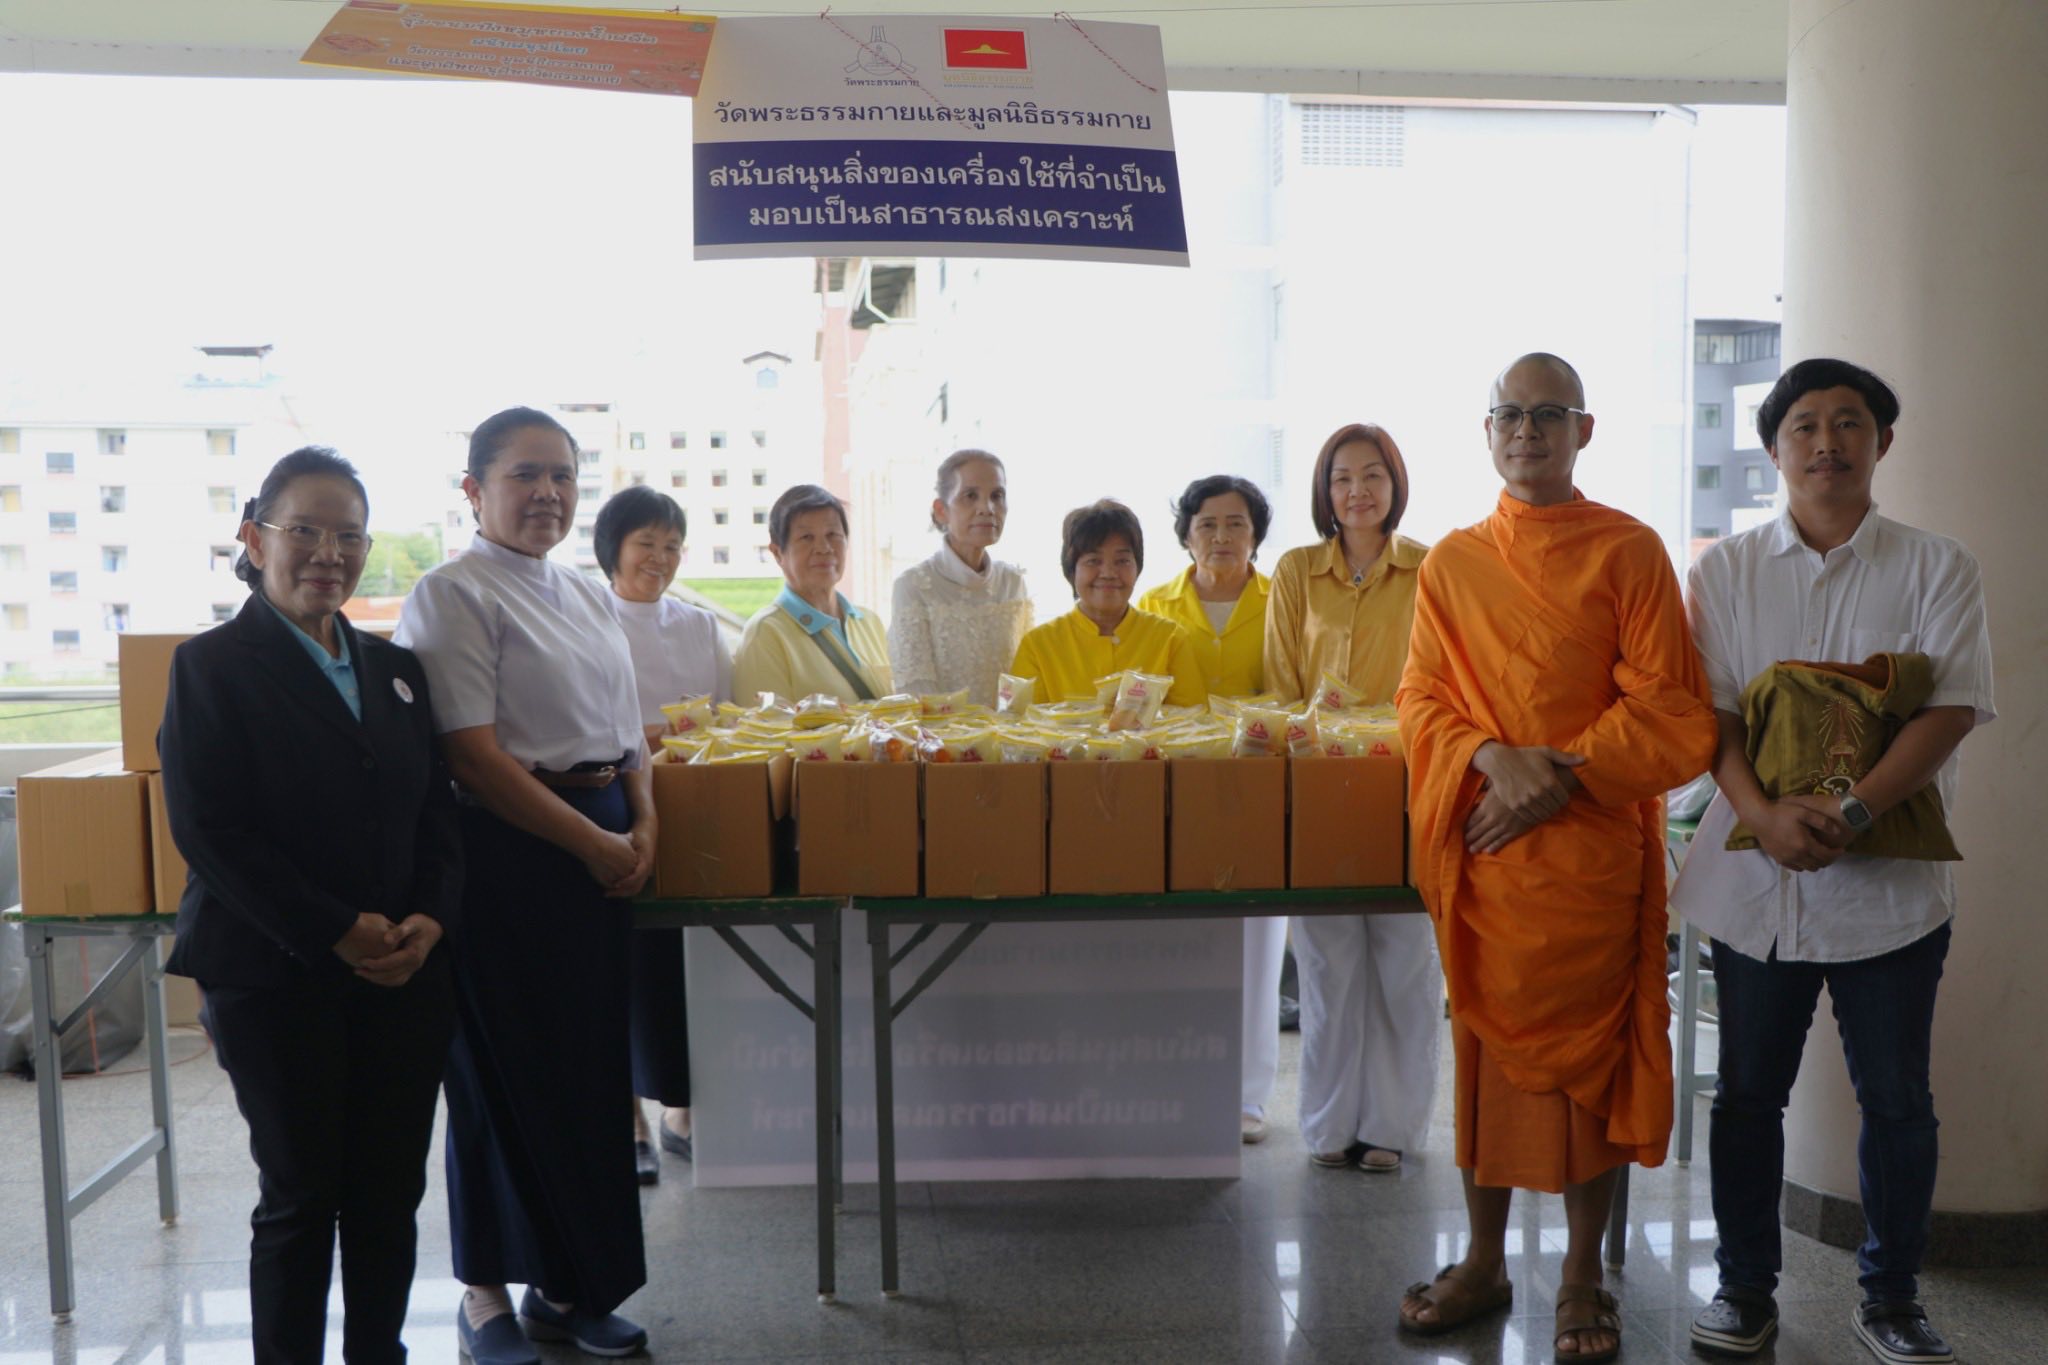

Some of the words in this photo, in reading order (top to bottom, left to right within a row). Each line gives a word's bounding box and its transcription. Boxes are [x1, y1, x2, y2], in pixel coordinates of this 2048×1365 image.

[843, 77, 919, 88] วัดพระธรรมกาย
[713, 100, 1152, 131] วัดพระธรรมกายและมูลนิธิธรรมกาย
[708, 151, 1167, 194] สนับสนุนสิ่งของเครื่องใช้ที่จำเป็น
[748, 195, 1135, 232] มอบเป็นสาธารณสงเคราะห์
